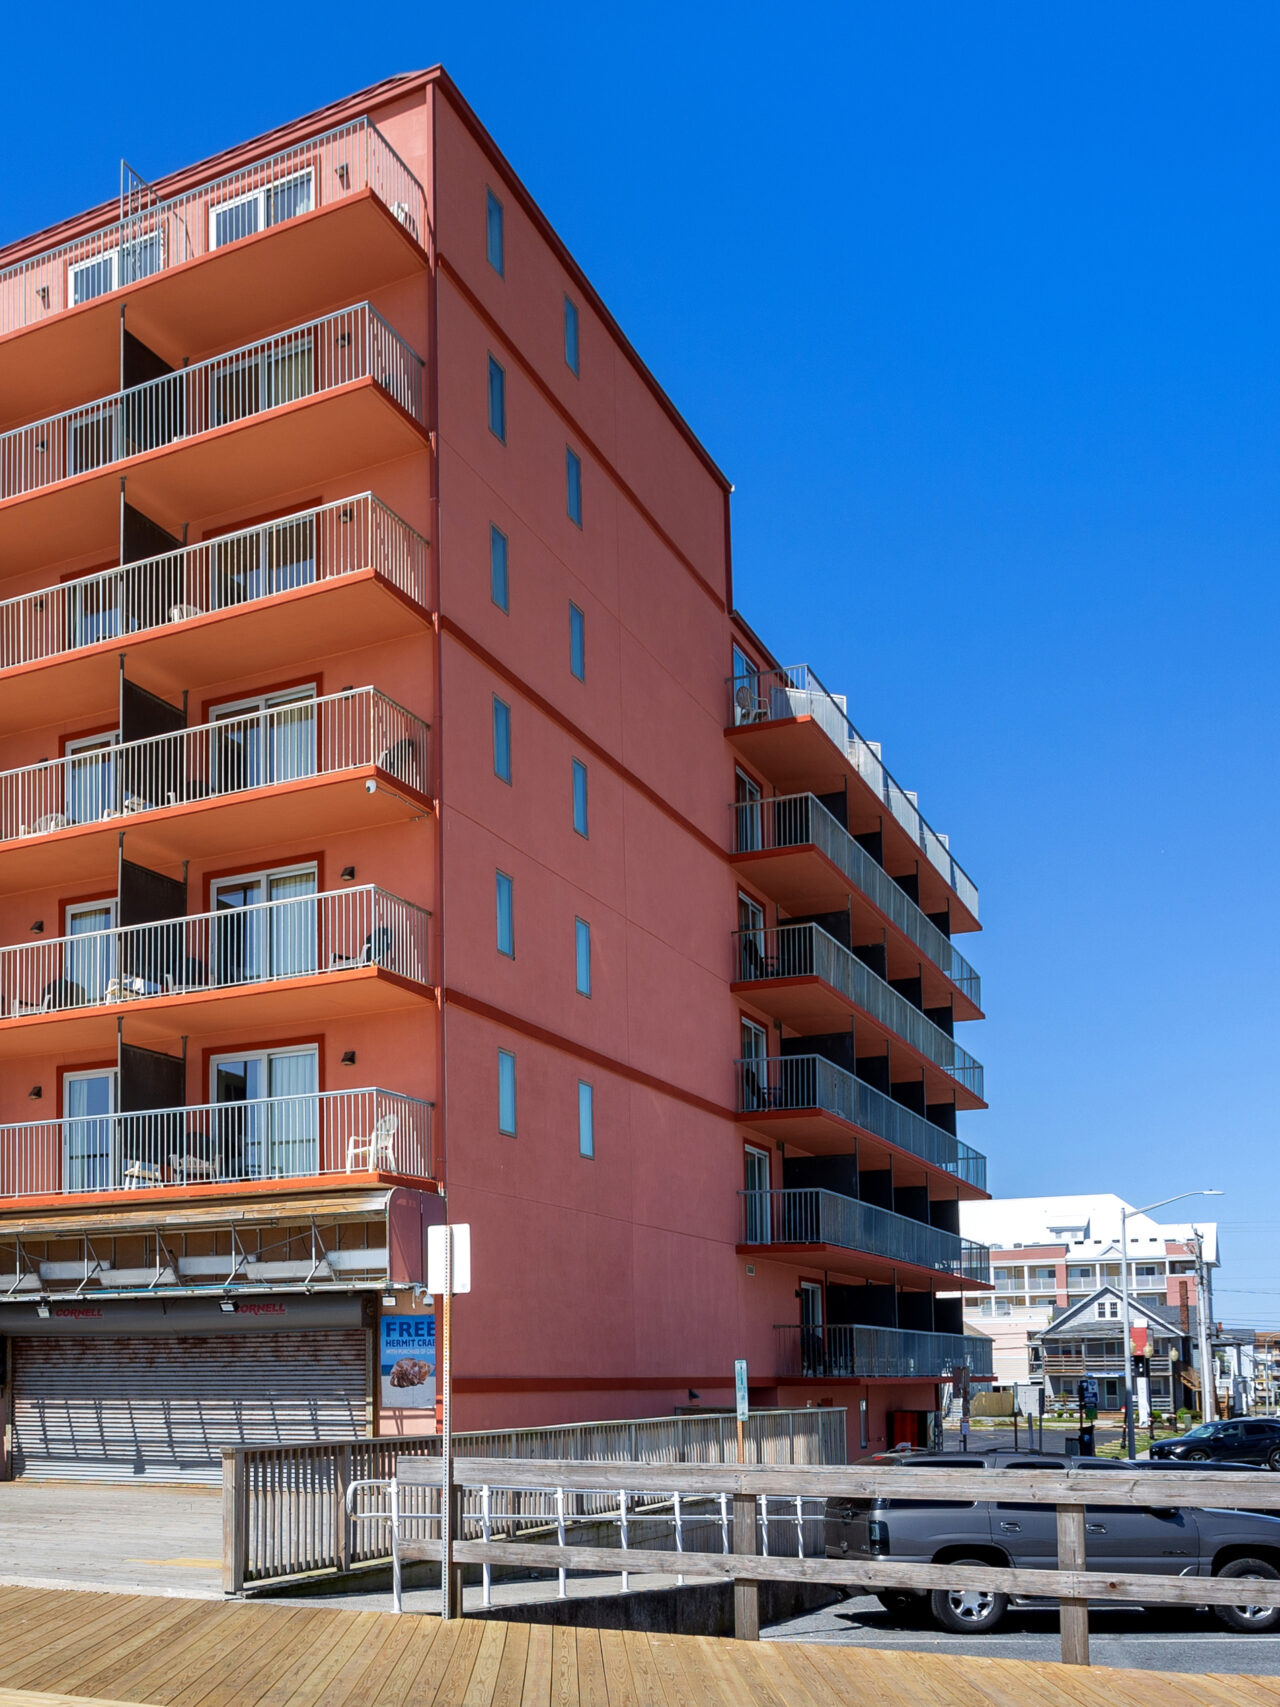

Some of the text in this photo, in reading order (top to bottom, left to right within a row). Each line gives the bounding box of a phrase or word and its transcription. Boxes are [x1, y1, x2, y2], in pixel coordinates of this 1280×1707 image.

[55, 1307, 103, 1319] CORNELL
[235, 1302, 286, 1315] ORNELL
[386, 1321, 435, 1337] FREE
[386, 1339, 415, 1347] HERMIT
